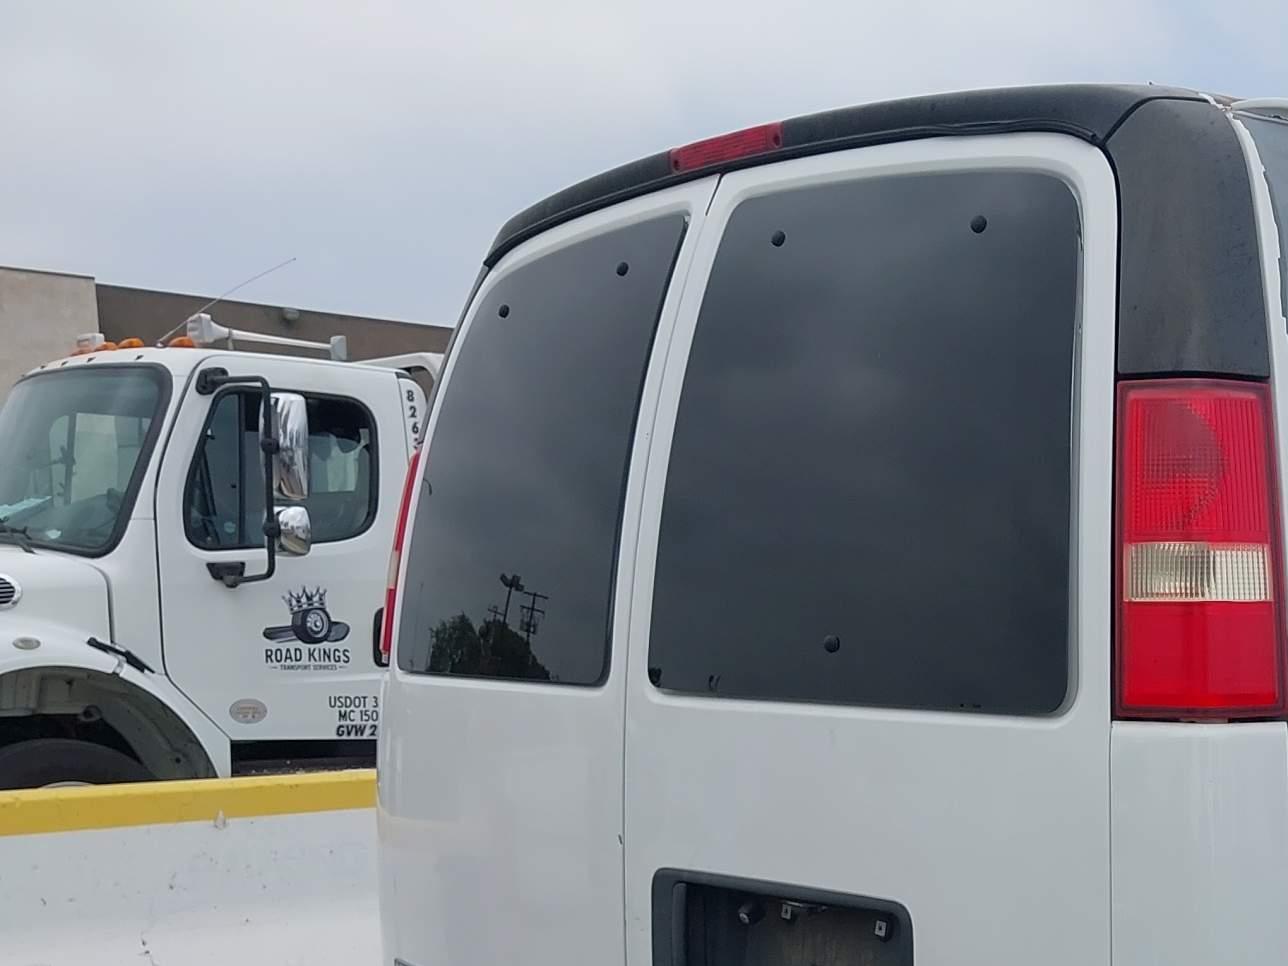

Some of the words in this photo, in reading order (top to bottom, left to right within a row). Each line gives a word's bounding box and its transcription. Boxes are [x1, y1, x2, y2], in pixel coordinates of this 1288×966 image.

[265, 647, 303, 664] ROAD
[307, 647, 351, 664] KINGS
[328, 695, 368, 709] USDOT
[338, 709, 356, 722] MC
[336, 724, 367, 737] GVW
